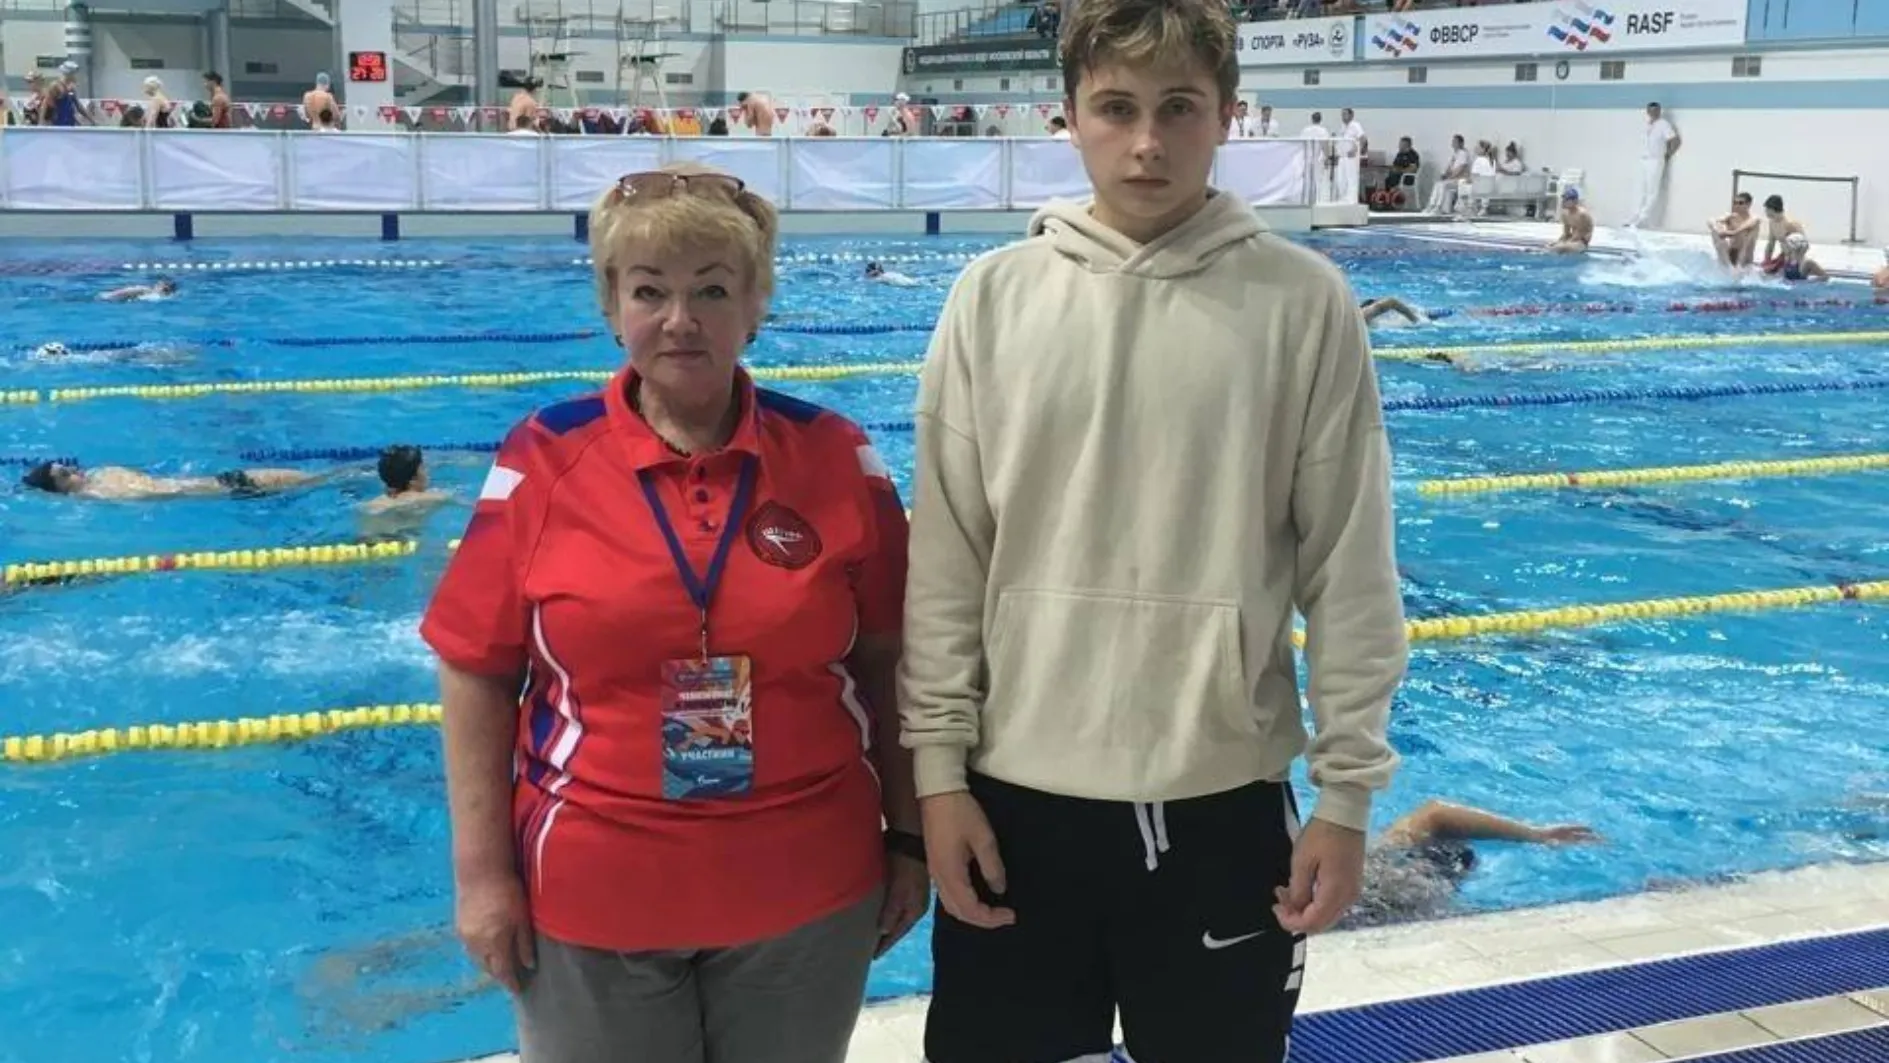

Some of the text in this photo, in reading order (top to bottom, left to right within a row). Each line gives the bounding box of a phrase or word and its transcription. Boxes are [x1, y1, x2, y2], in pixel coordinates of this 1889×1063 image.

[1626, 11, 1674, 34] RASF
[1251, 35, 1285, 50] СПОРТА
[1430, 24, 1479, 44] ФВВСР
